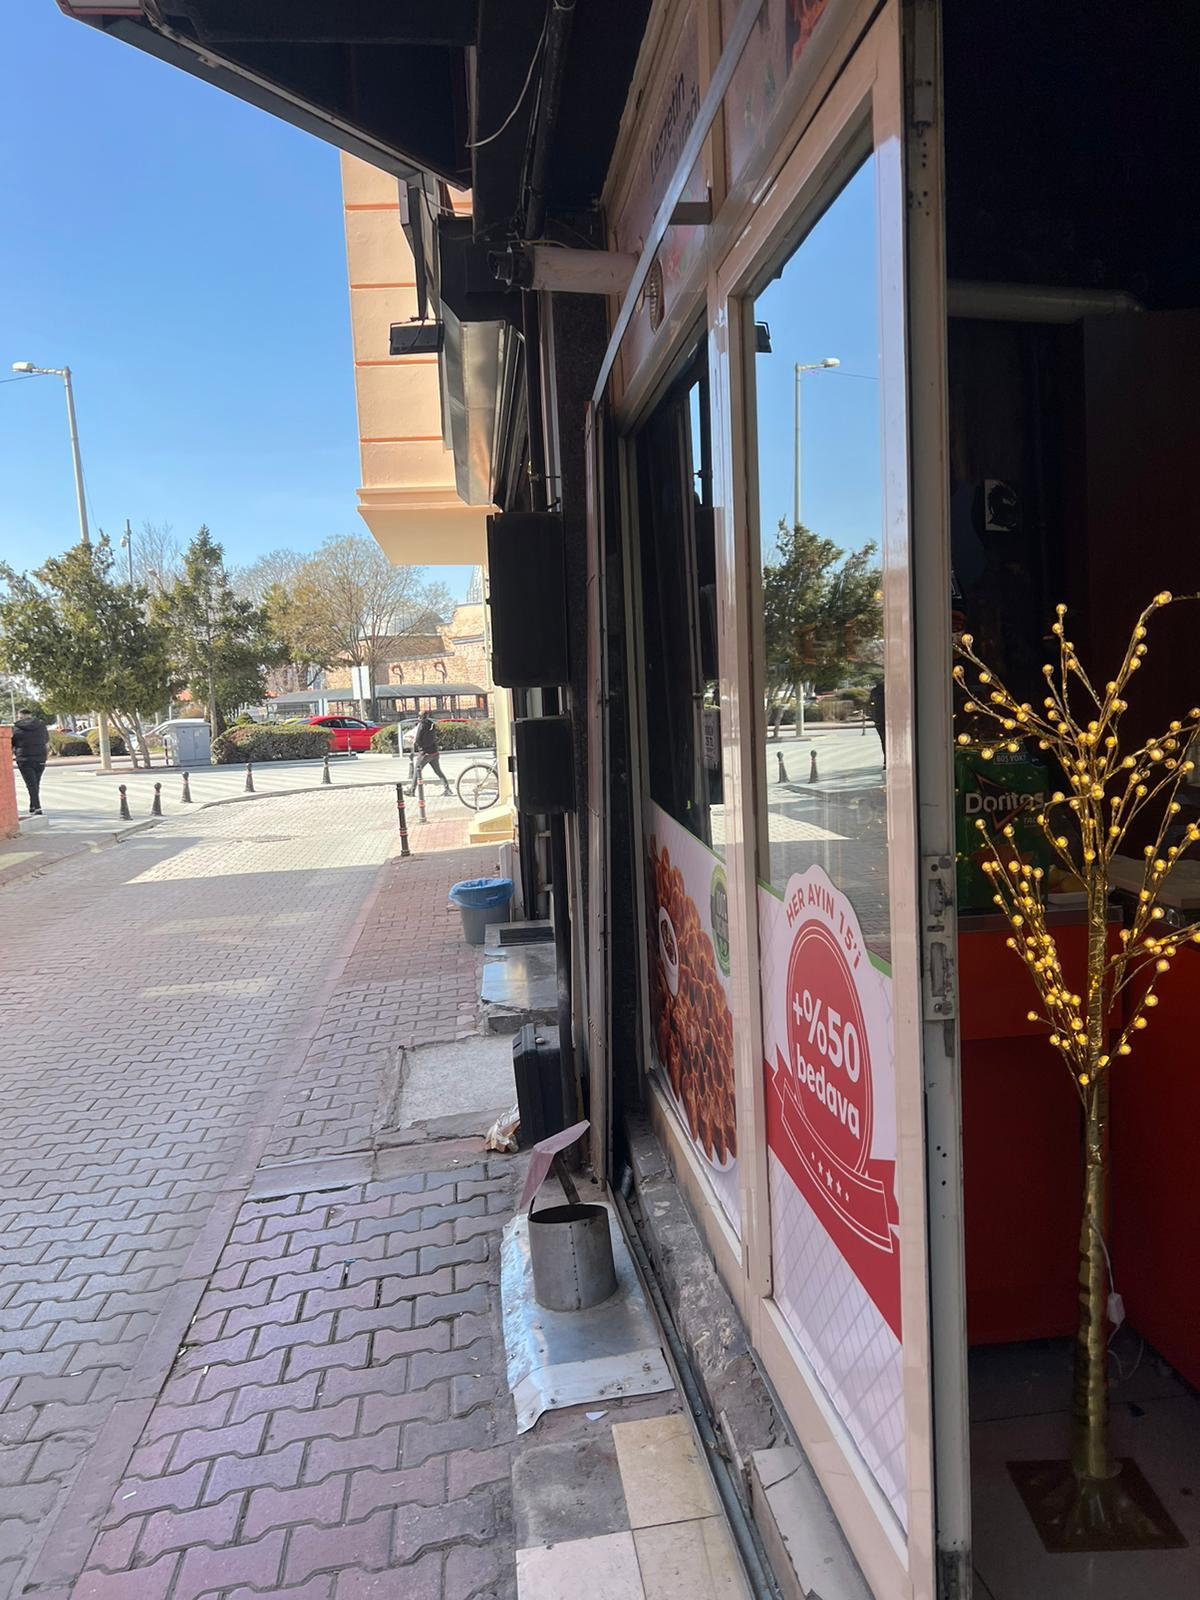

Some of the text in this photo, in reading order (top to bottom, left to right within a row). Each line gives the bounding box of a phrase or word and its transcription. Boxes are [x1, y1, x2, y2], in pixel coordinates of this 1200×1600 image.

[965, 791, 1044, 814] Doritos
[786, 887, 805, 929] HER
[808, 883, 834, 920] AYIN
[793, 989, 860, 1083] +%50
[796, 1042, 860, 1140] bedava
